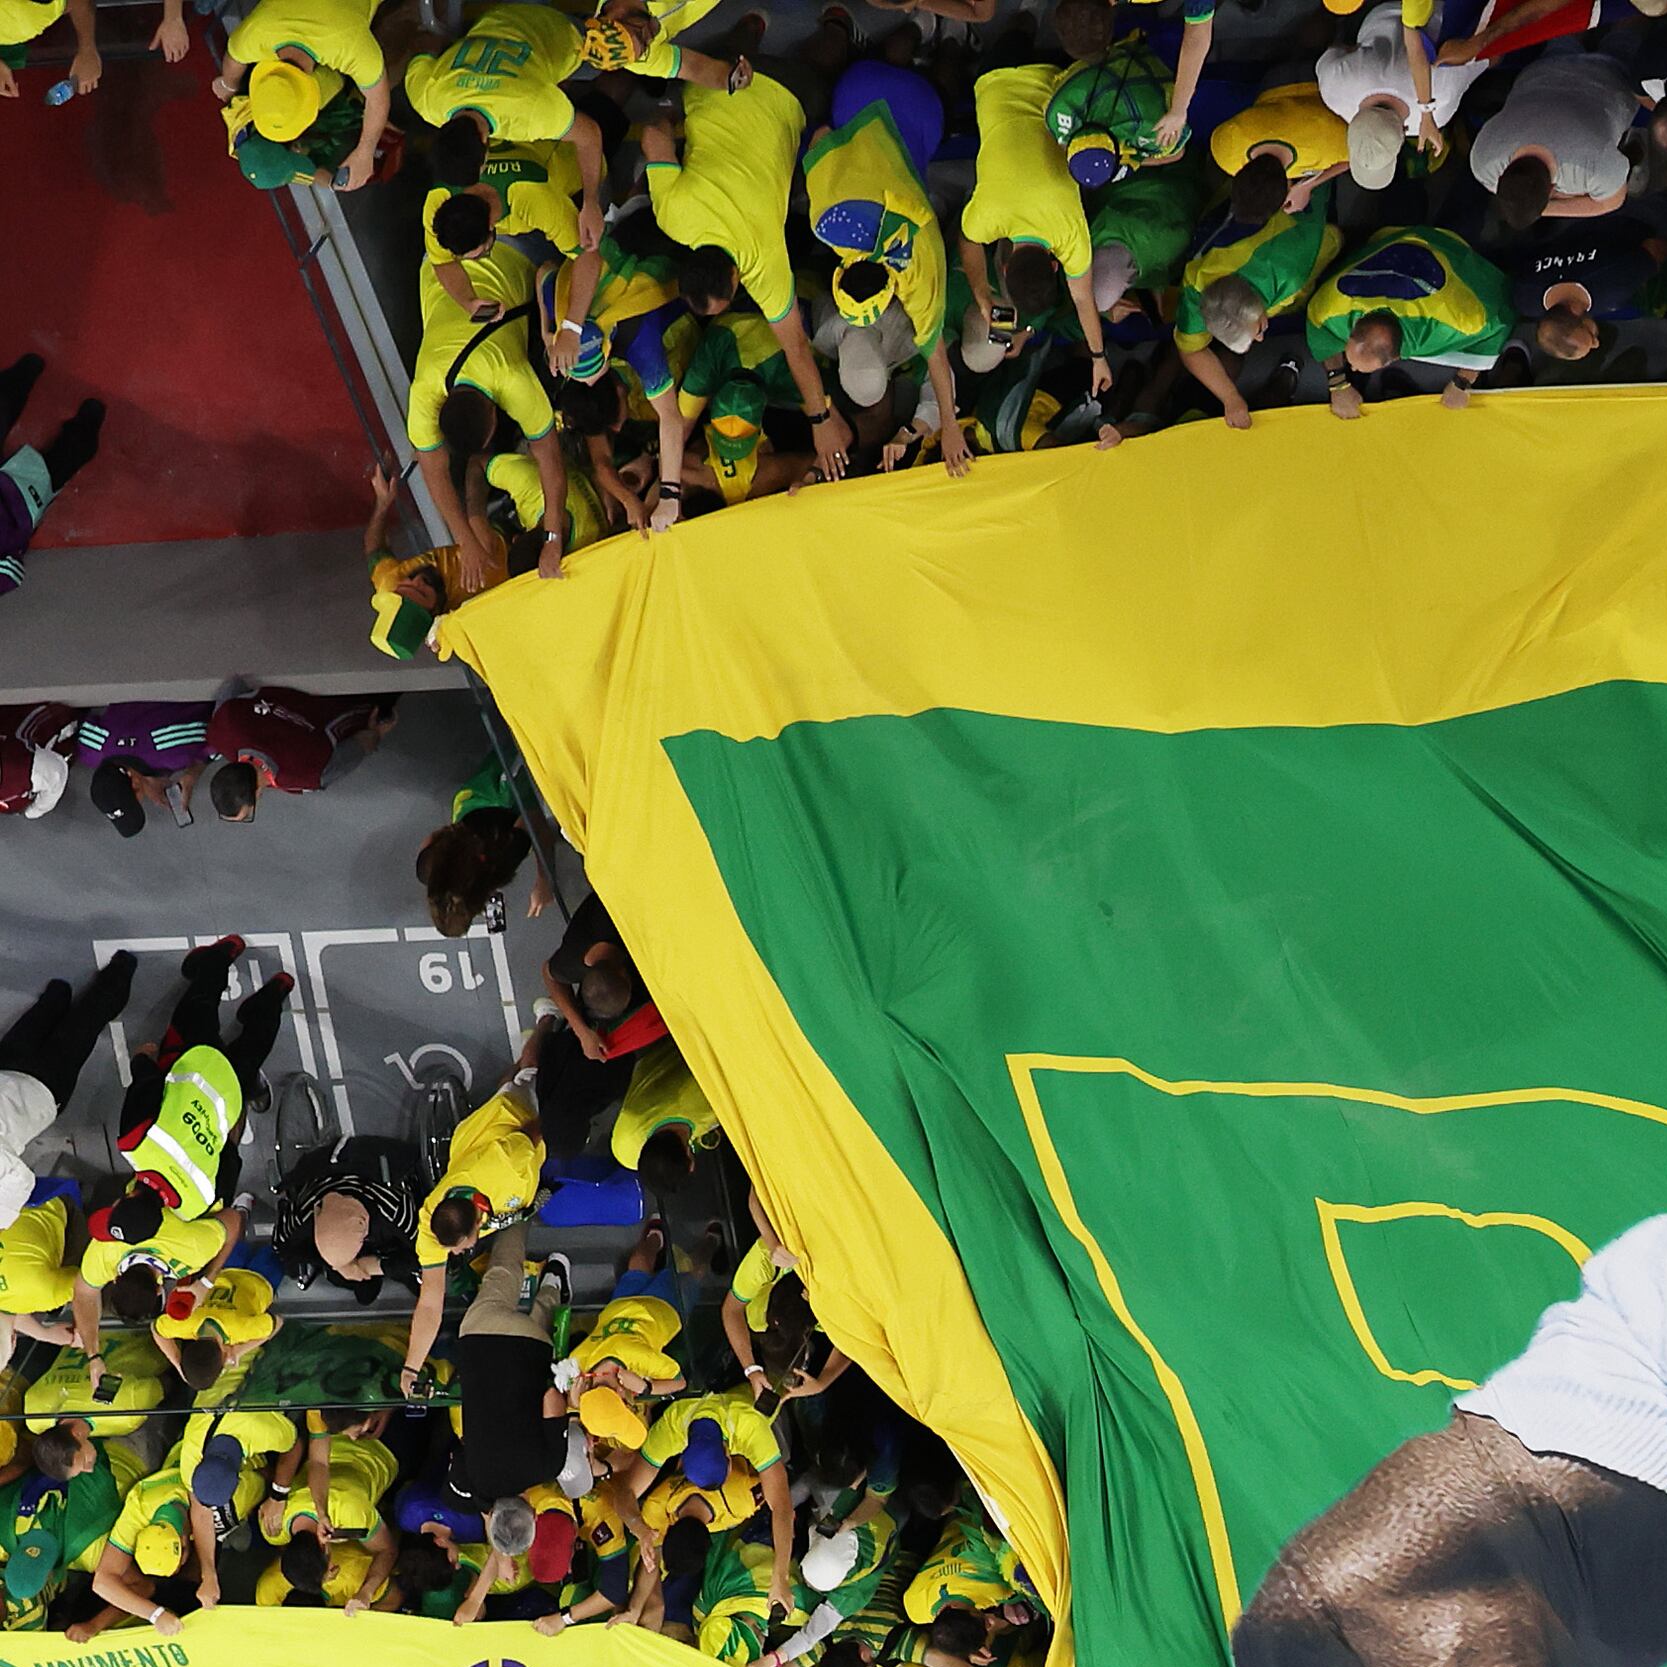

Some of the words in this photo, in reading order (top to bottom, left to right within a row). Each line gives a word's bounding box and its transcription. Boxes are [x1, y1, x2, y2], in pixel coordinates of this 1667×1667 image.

[450, 36, 532, 77] 20
[1534, 247, 1596, 271] FRANCE
[419, 951, 486, 994] 19
